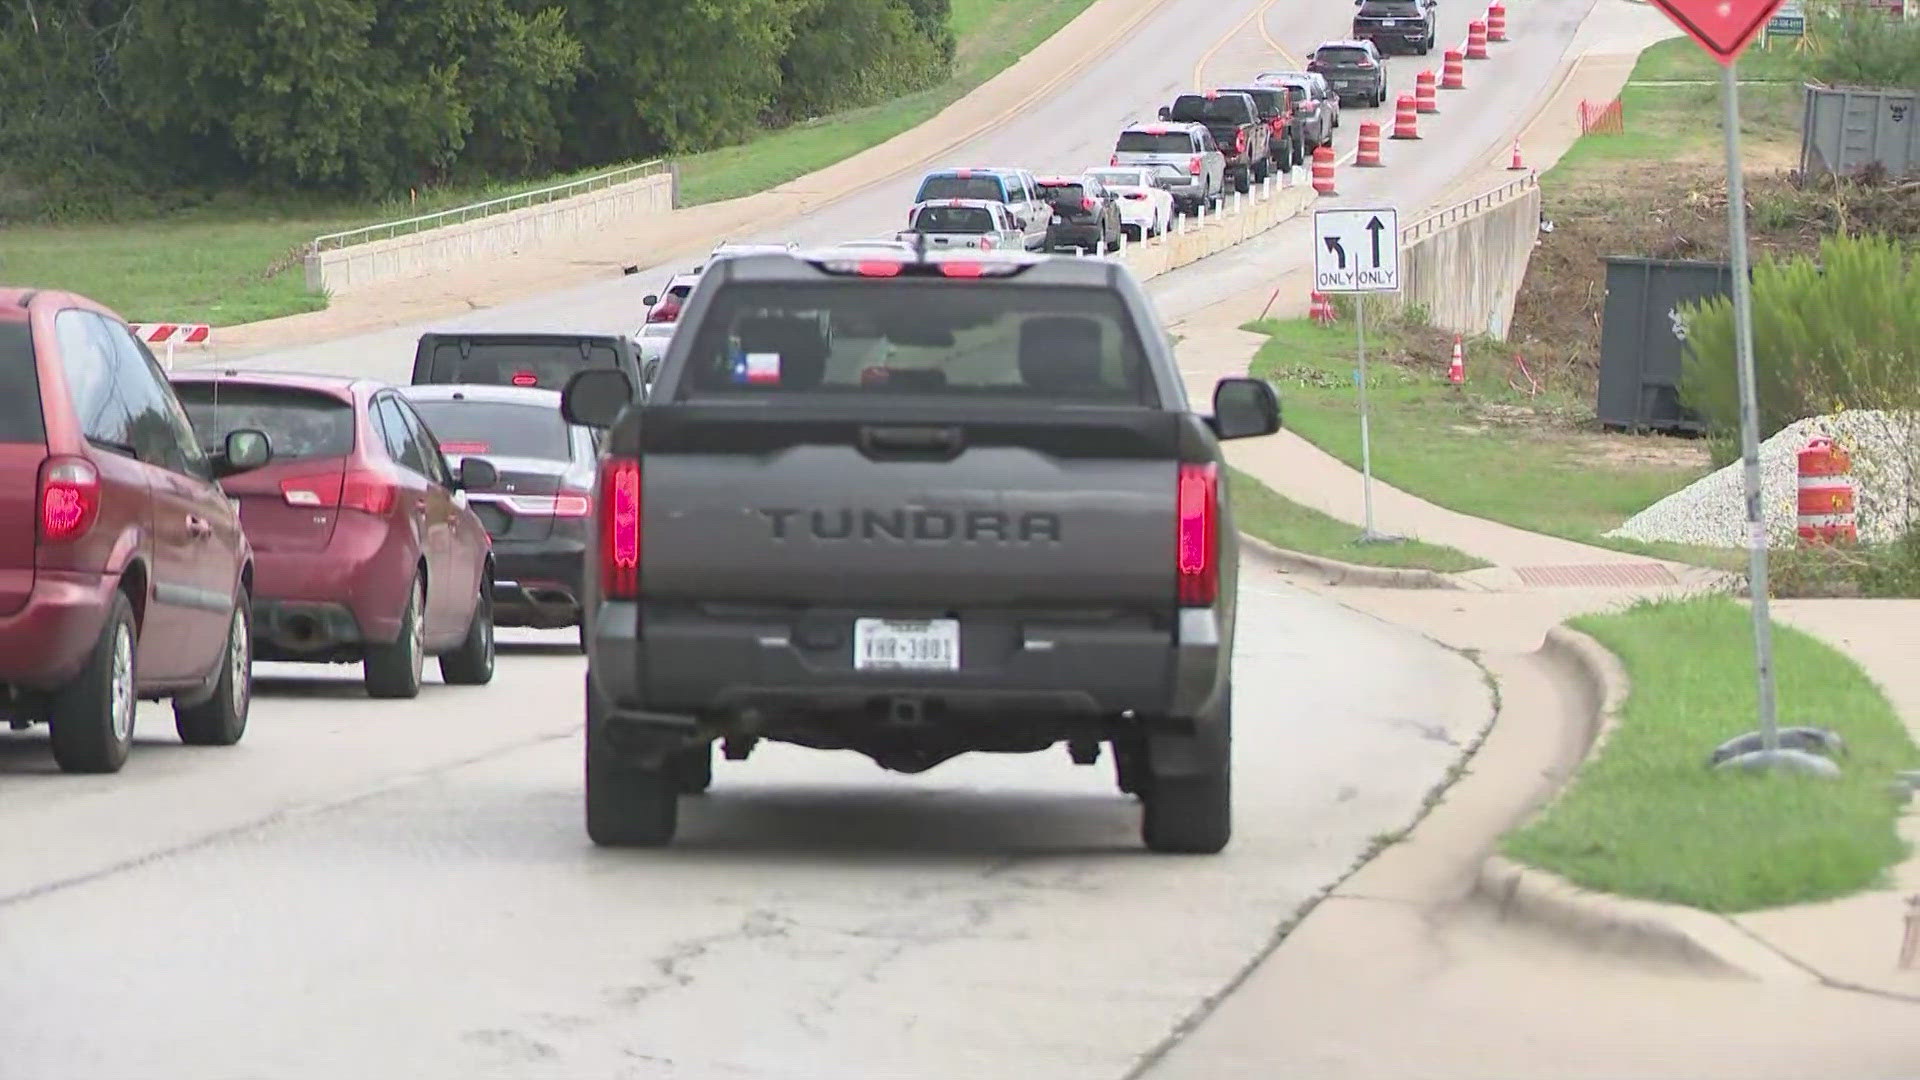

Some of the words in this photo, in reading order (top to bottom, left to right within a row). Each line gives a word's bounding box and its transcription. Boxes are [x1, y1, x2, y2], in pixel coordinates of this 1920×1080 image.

[1320, 273, 1354, 285] ONLY
[1359, 271, 1394, 284] ONLY
[761, 507, 1062, 542] TUNDRA
